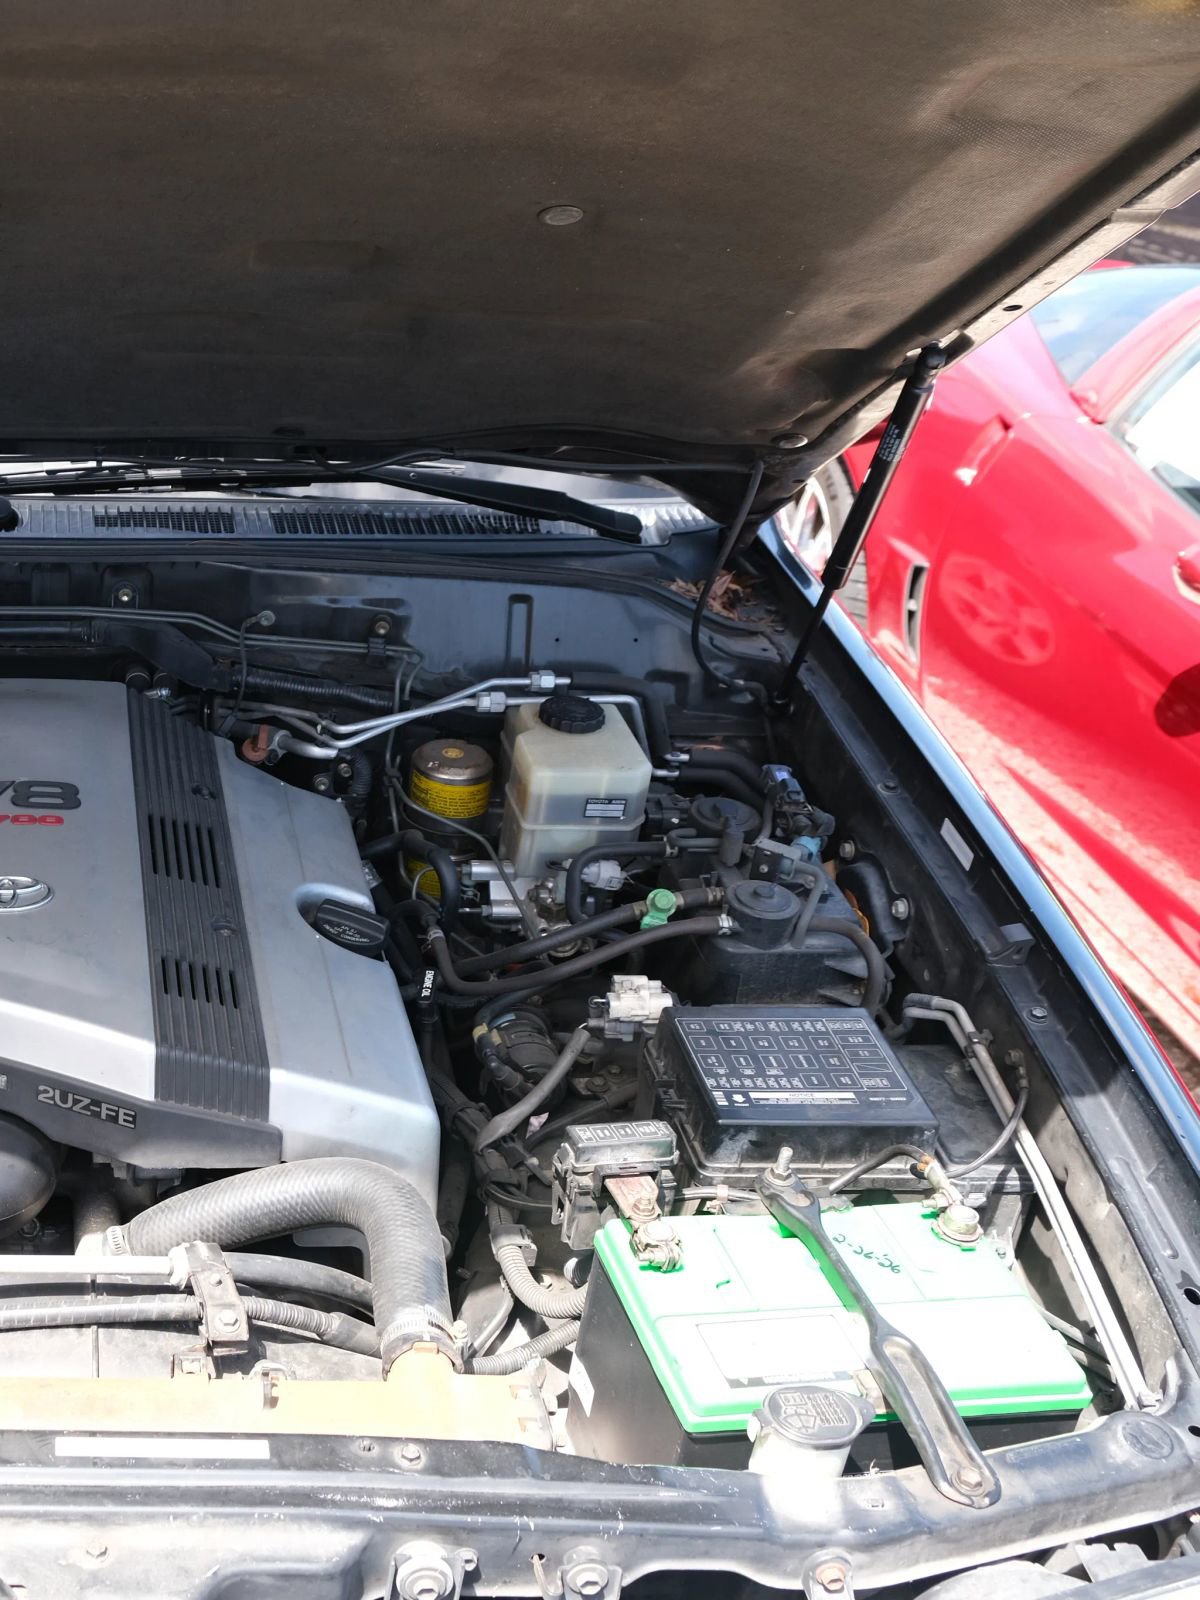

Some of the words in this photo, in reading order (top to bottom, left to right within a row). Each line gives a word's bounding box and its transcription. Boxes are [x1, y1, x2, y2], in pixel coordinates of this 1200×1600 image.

[422, 970, 435, 988] ENGINE
[421, 988, 431, 997] OIL
[37, 1085, 136, 1128] 2UZ-FE
